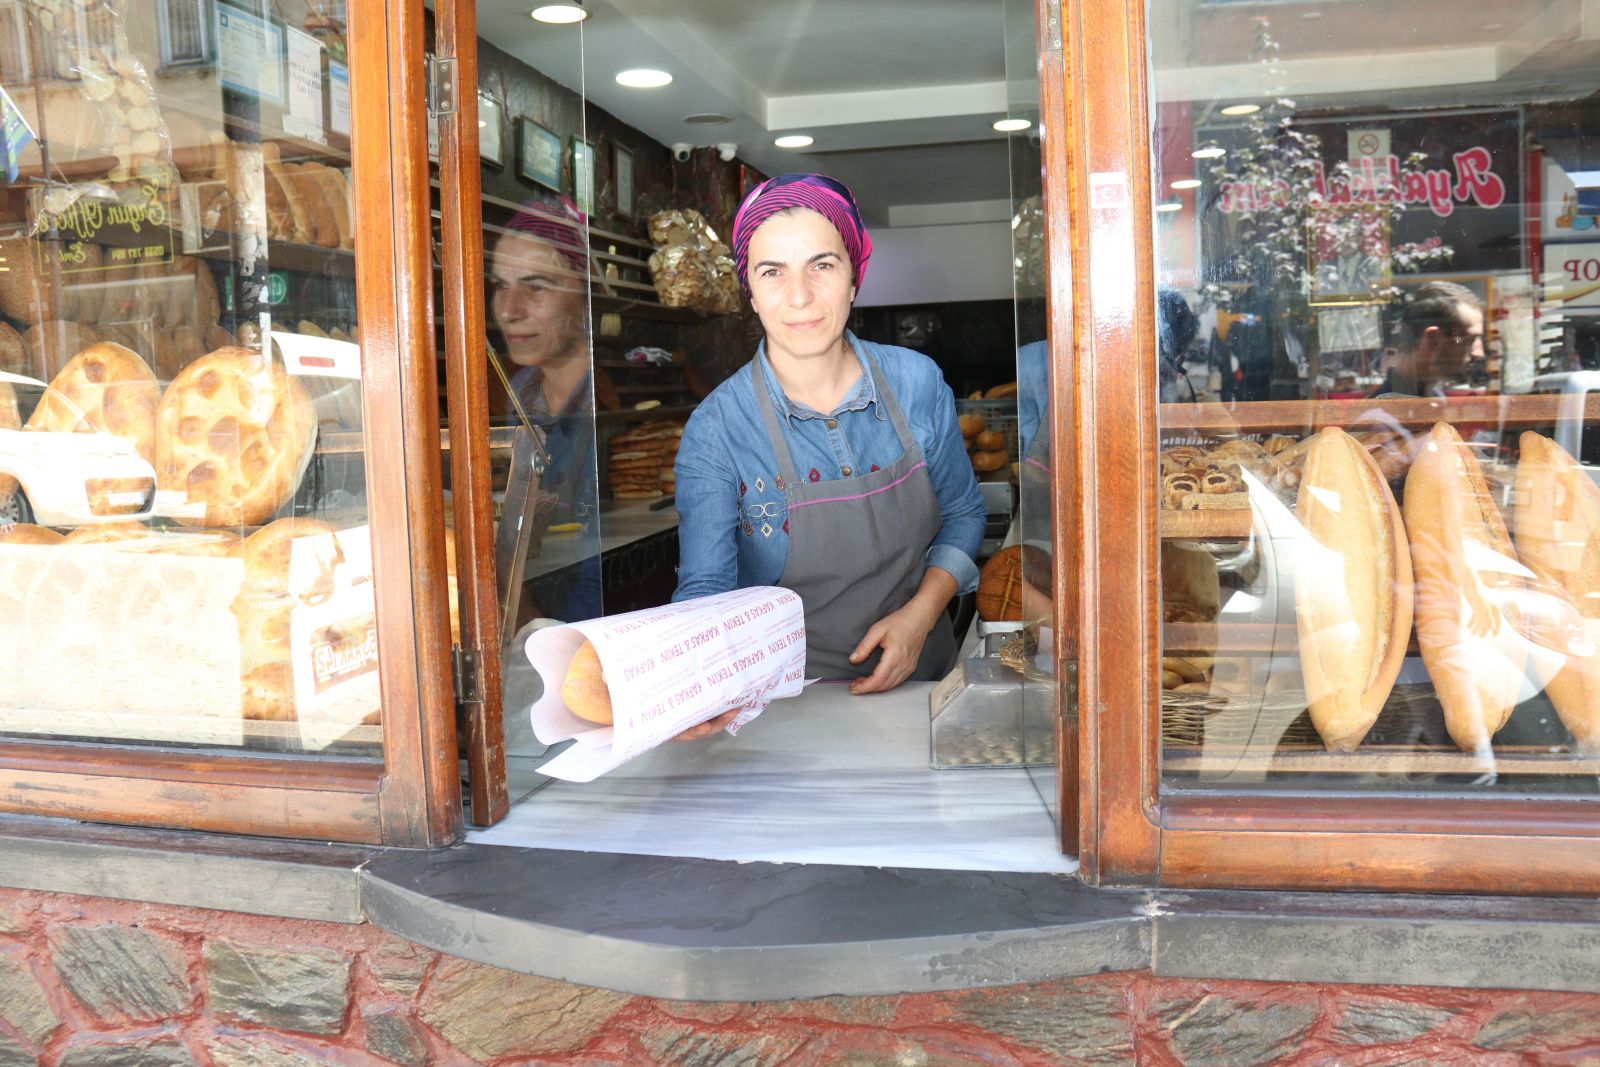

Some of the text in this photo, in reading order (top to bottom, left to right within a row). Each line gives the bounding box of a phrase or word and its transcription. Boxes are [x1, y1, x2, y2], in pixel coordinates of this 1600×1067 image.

[750, 600, 775, 621] KAFKAS
[690, 624, 721, 649] KAFKAS
[741, 647, 765, 671] KAFKAS
[674, 681, 702, 707] KAFKAS
